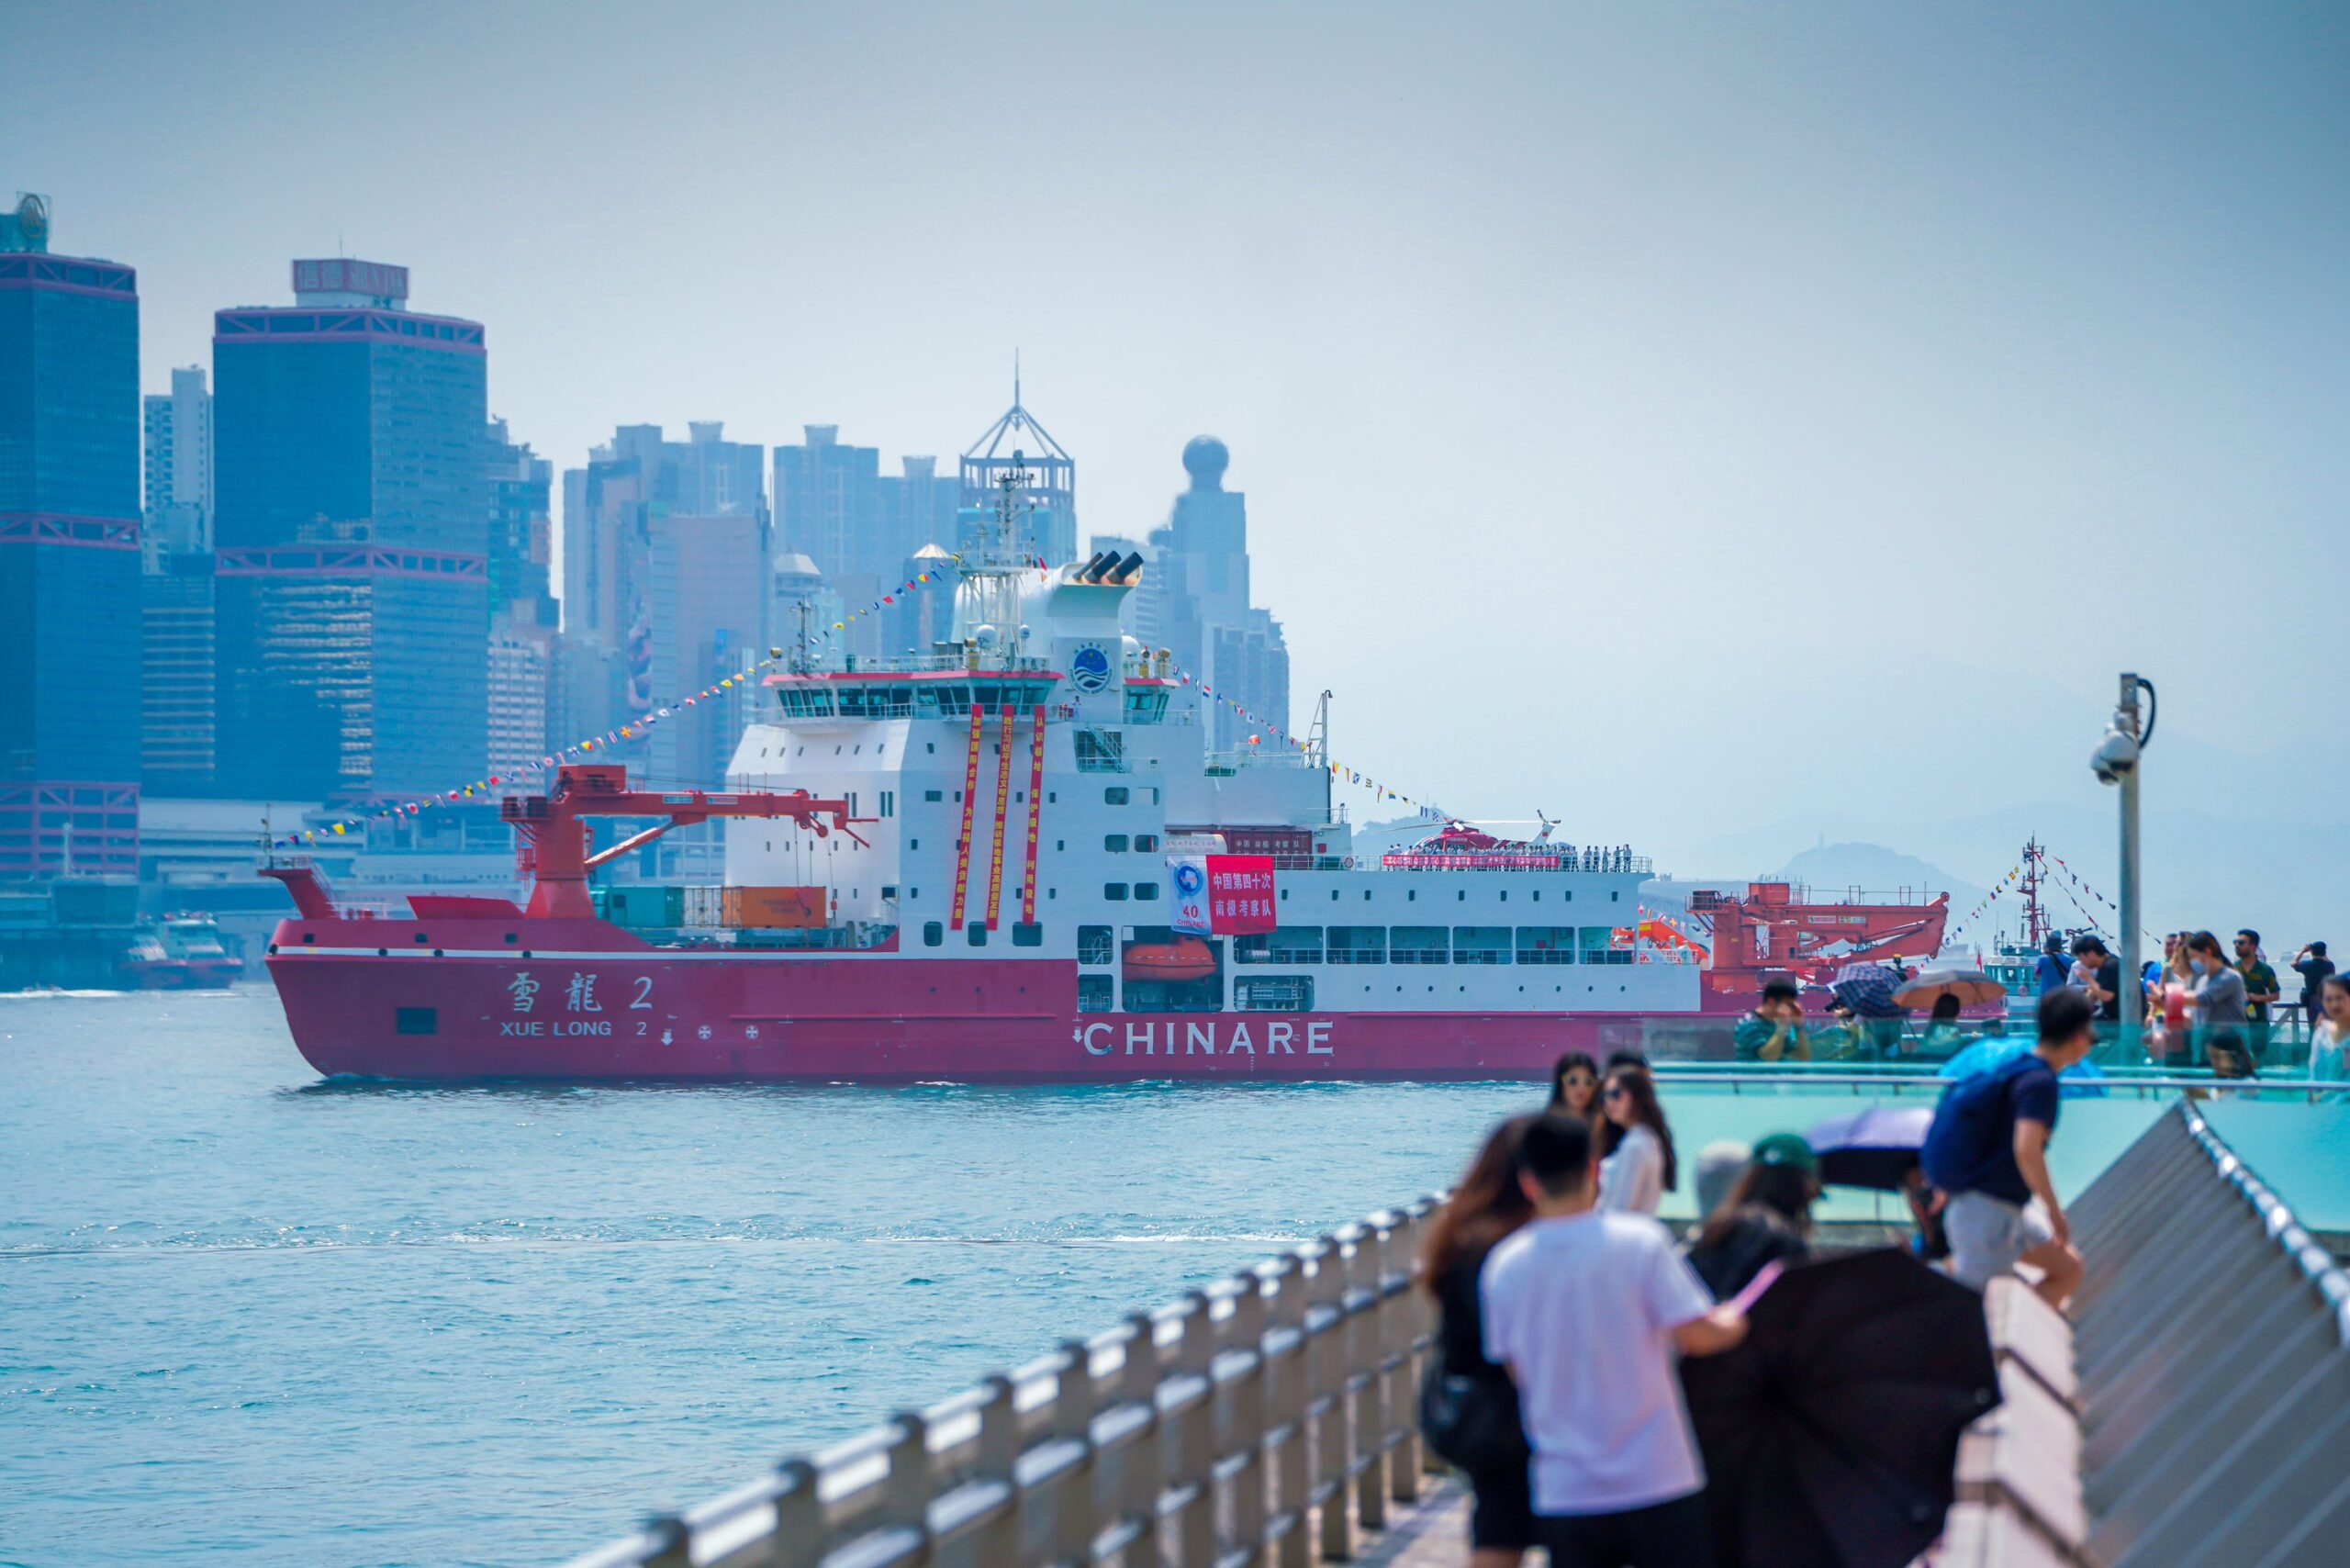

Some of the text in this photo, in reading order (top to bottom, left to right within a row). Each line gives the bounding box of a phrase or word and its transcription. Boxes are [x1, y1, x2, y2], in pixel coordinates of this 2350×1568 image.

[1213, 872, 1271, 890] 中国第四十次
[1182, 904, 1199, 919] 40
[1215, 899, 1271, 917] 南极考察队
[508, 971, 654, 1013] 雪龍 2
[499, 1021, 647, 1036] XUE LONG 2
[1083, 1021, 1334, 1056] CHINARE
